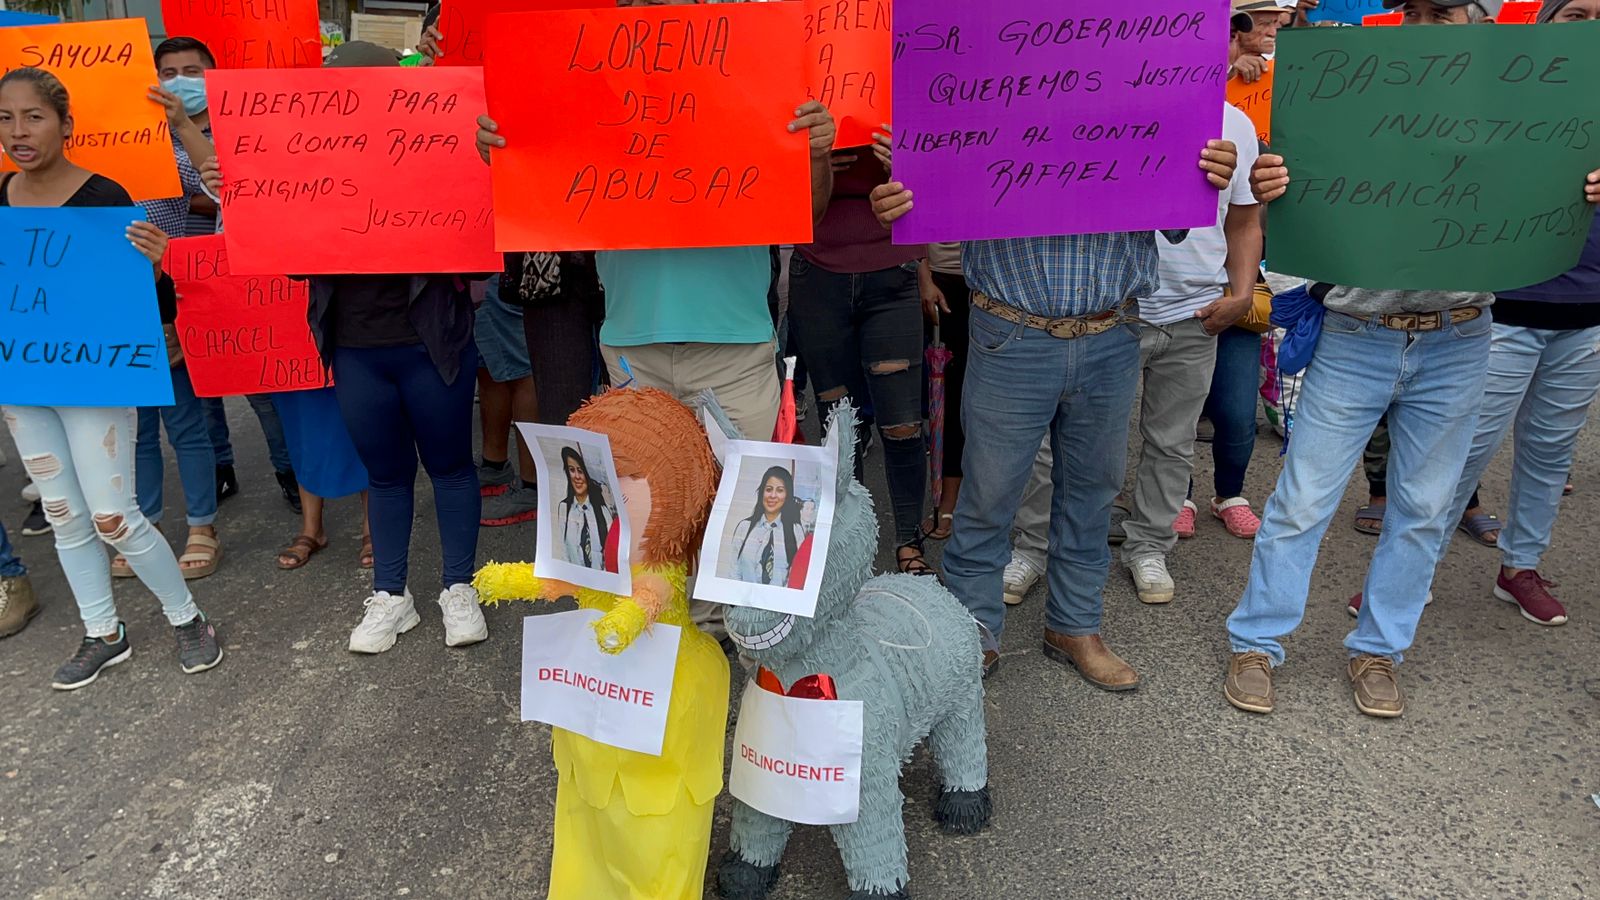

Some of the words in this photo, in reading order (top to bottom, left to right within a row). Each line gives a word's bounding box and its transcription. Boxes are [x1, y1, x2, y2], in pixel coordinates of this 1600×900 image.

[568, 16, 730, 76] LORENA
[998, 12, 1206, 56] GOBERNADOR
[20, 42, 133, 68] SAYULA
[818, 43, 834, 74] A
[1498, 55, 1569, 84] DE
[928, 72, 1102, 107] QUEREMOS
[1124, 60, 1224, 89] JUSTICIA
[219, 89, 360, 118] LIBERTAD
[387, 88, 458, 115] PARA
[597, 90, 696, 125] DEJA
[234, 135, 267, 156] EL
[286, 132, 368, 155] CONTA
[386, 128, 459, 167] RAFA
[623, 132, 669, 159] DE
[897, 127, 999, 154] LIBEREN
[1022, 125, 1054, 147] AL
[1073, 121, 1160, 143] CONTA
[1368, 114, 1593, 150] INJUSTICIAS
[565, 164, 759, 224] ABUSAR
[986, 159, 1119, 207] RAFAEL
[1293, 176, 1479, 212] FABRICAR
[24, 228, 71, 267] TU
[10, 284, 49, 315] LA
[184, 326, 284, 358] CARCEL
[538, 668, 655, 708] DELINCUENTE
[741, 743, 845, 782] DELINCUENTE
